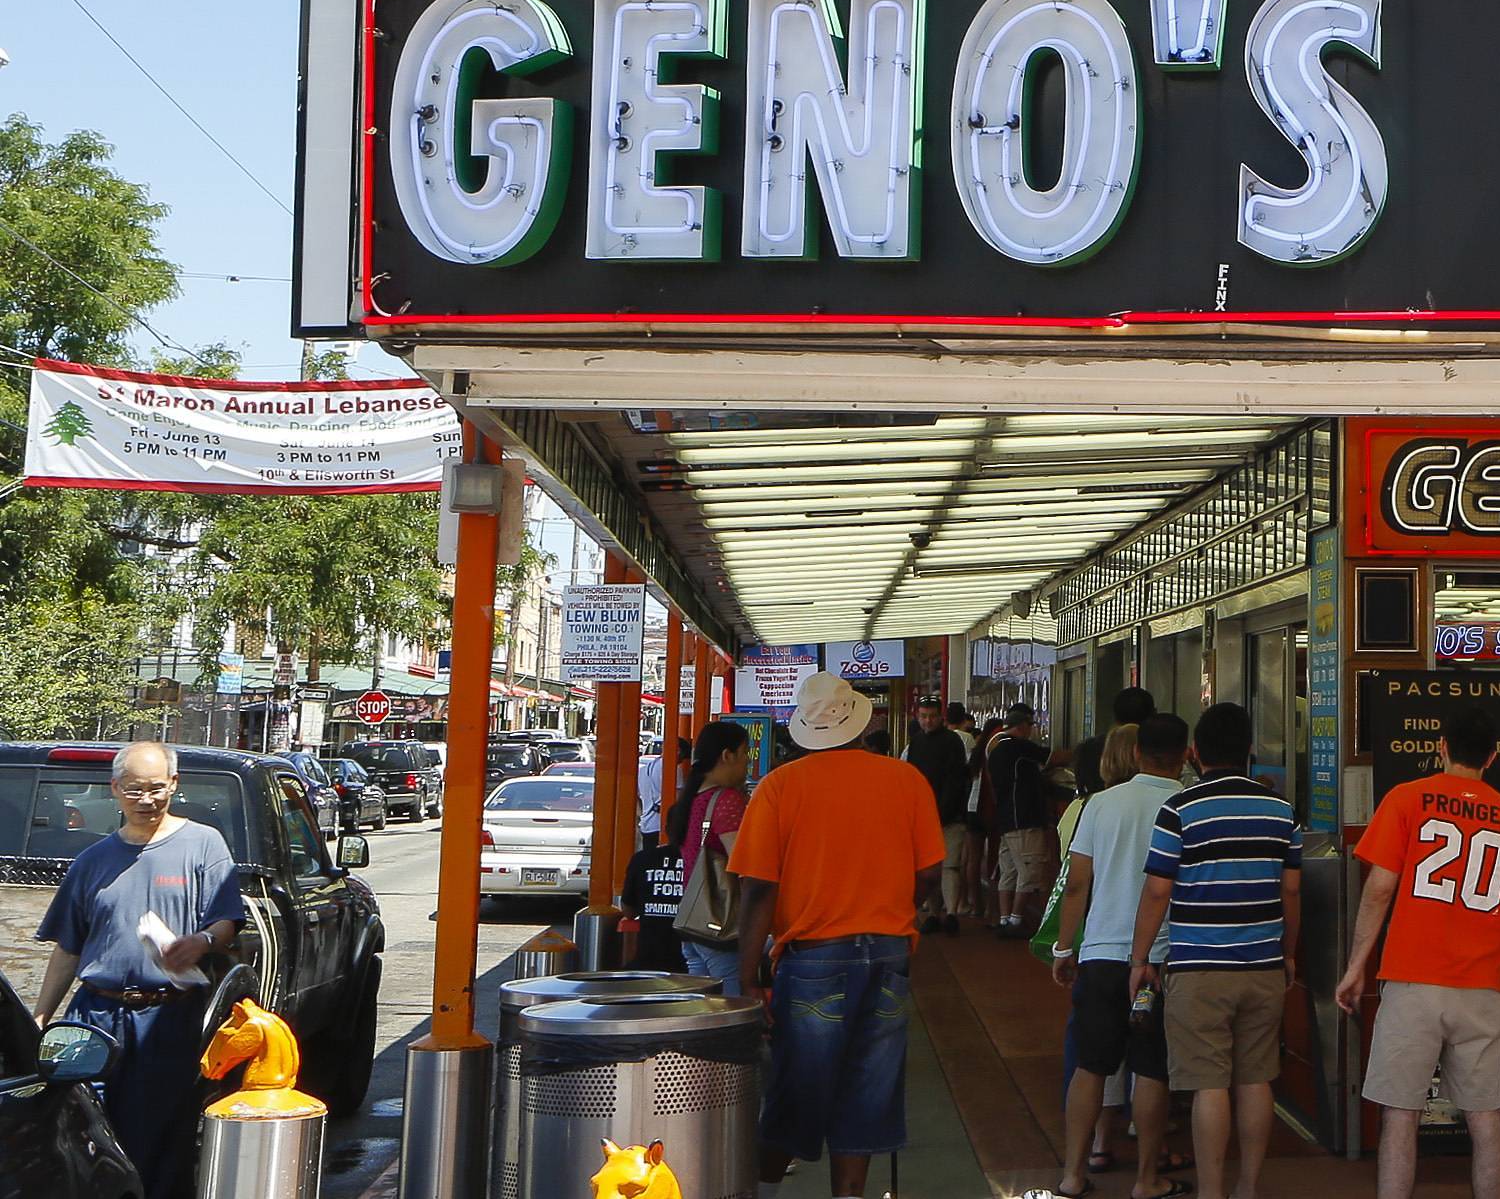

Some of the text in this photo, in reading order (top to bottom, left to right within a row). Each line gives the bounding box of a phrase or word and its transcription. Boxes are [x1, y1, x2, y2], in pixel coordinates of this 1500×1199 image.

[1215, 263, 1230, 312] FINX
[134, 388, 216, 411] Maron
[224, 396, 314, 414] Annual
[324, 397, 446, 414] Lebanese
[130, 426, 149, 439] Fri
[162, 430, 200, 443] June
[204, 434, 221, 445] 13
[123, 441, 227, 460] 5 PM to 11 PM
[276, 451, 380, 463] 3 PM to 11 PM
[289, 470, 299, 481] &
[379, 469, 395, 480] St
[566, 610, 640, 622] LEW BLUM
[569, 624, 609, 634] TOWING
[1435, 626, 1484, 655] O'S
[840, 660, 890, 676] Zoey's
[358, 701, 388, 714] STOP
[1404, 718, 1441, 730] FIND
[1418, 756, 1432, 772] of
[653, 883, 684, 896] FOR
